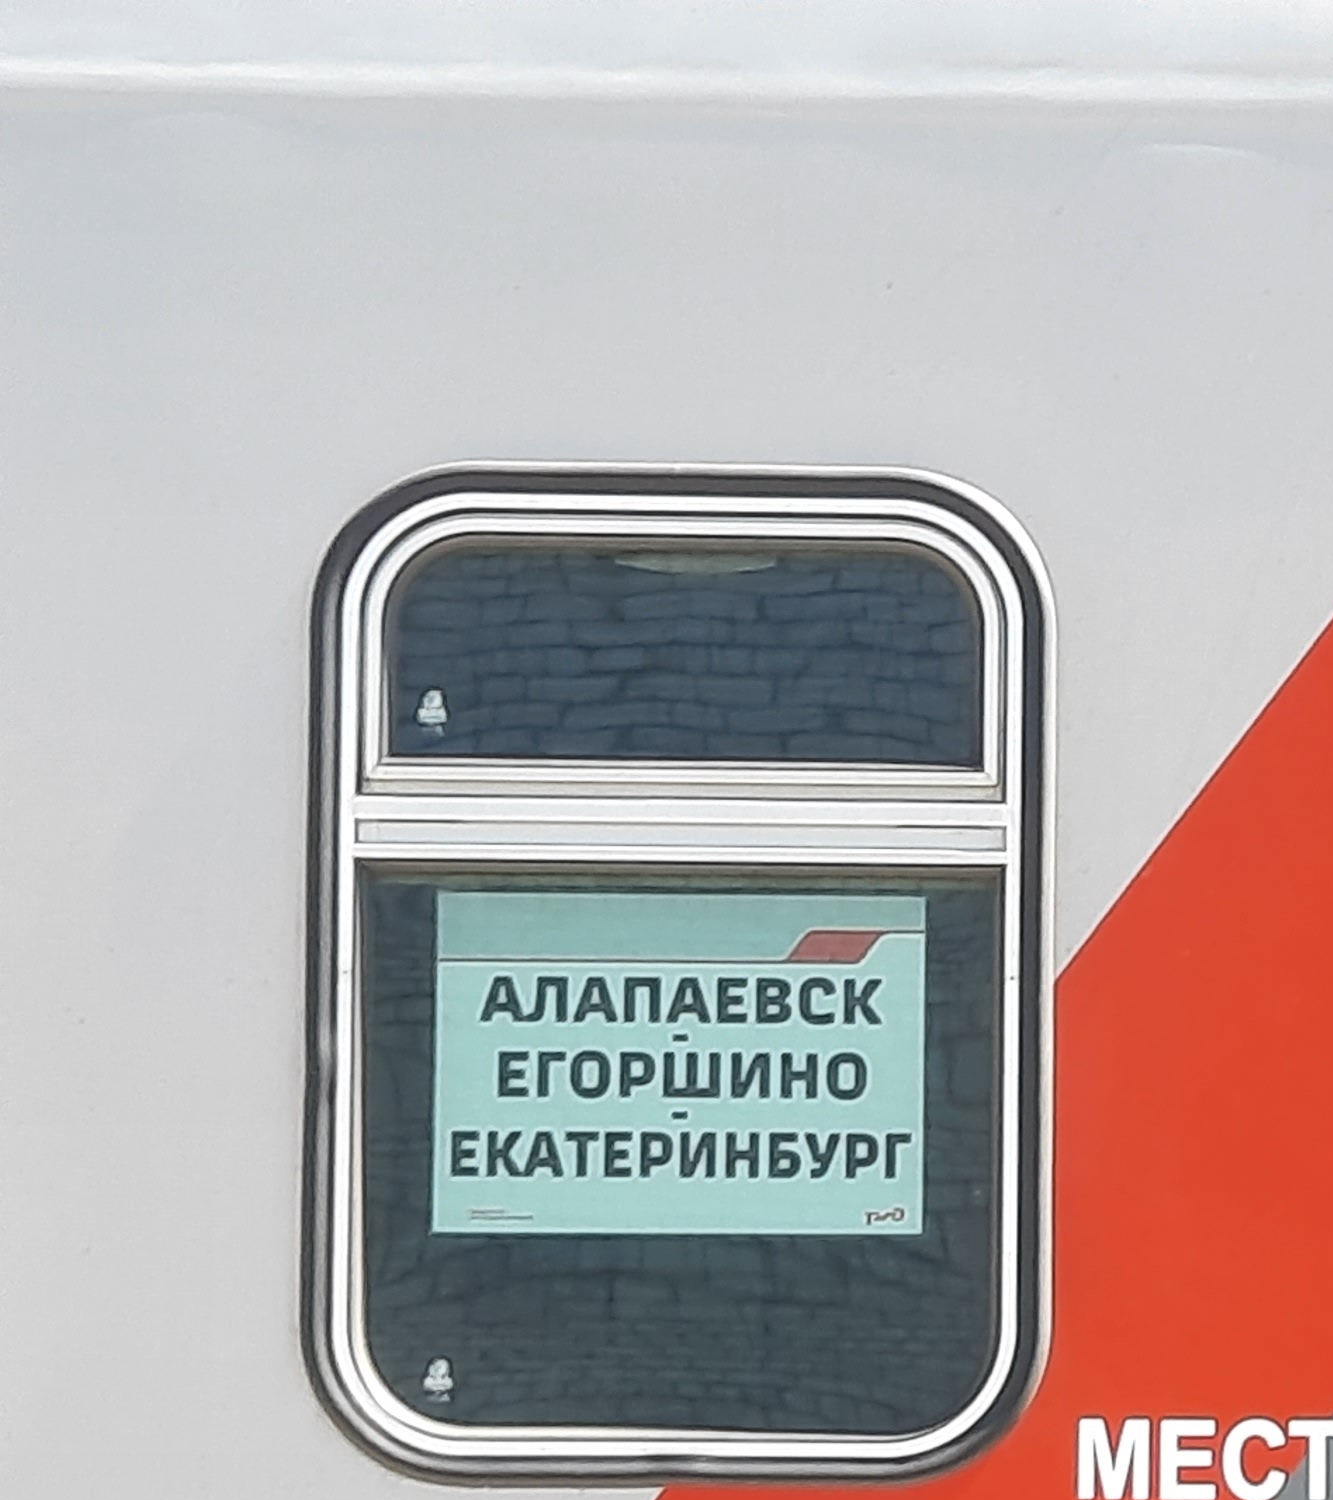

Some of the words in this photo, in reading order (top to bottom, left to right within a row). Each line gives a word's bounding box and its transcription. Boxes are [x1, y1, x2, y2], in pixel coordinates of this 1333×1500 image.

[479, 975, 883, 1025] АЛАПАЕВСК
[496, 1050, 869, 1101] ЕГОРШИНО
[449, 1130, 913, 1180] ЕКАТЕРИНБУРГ
